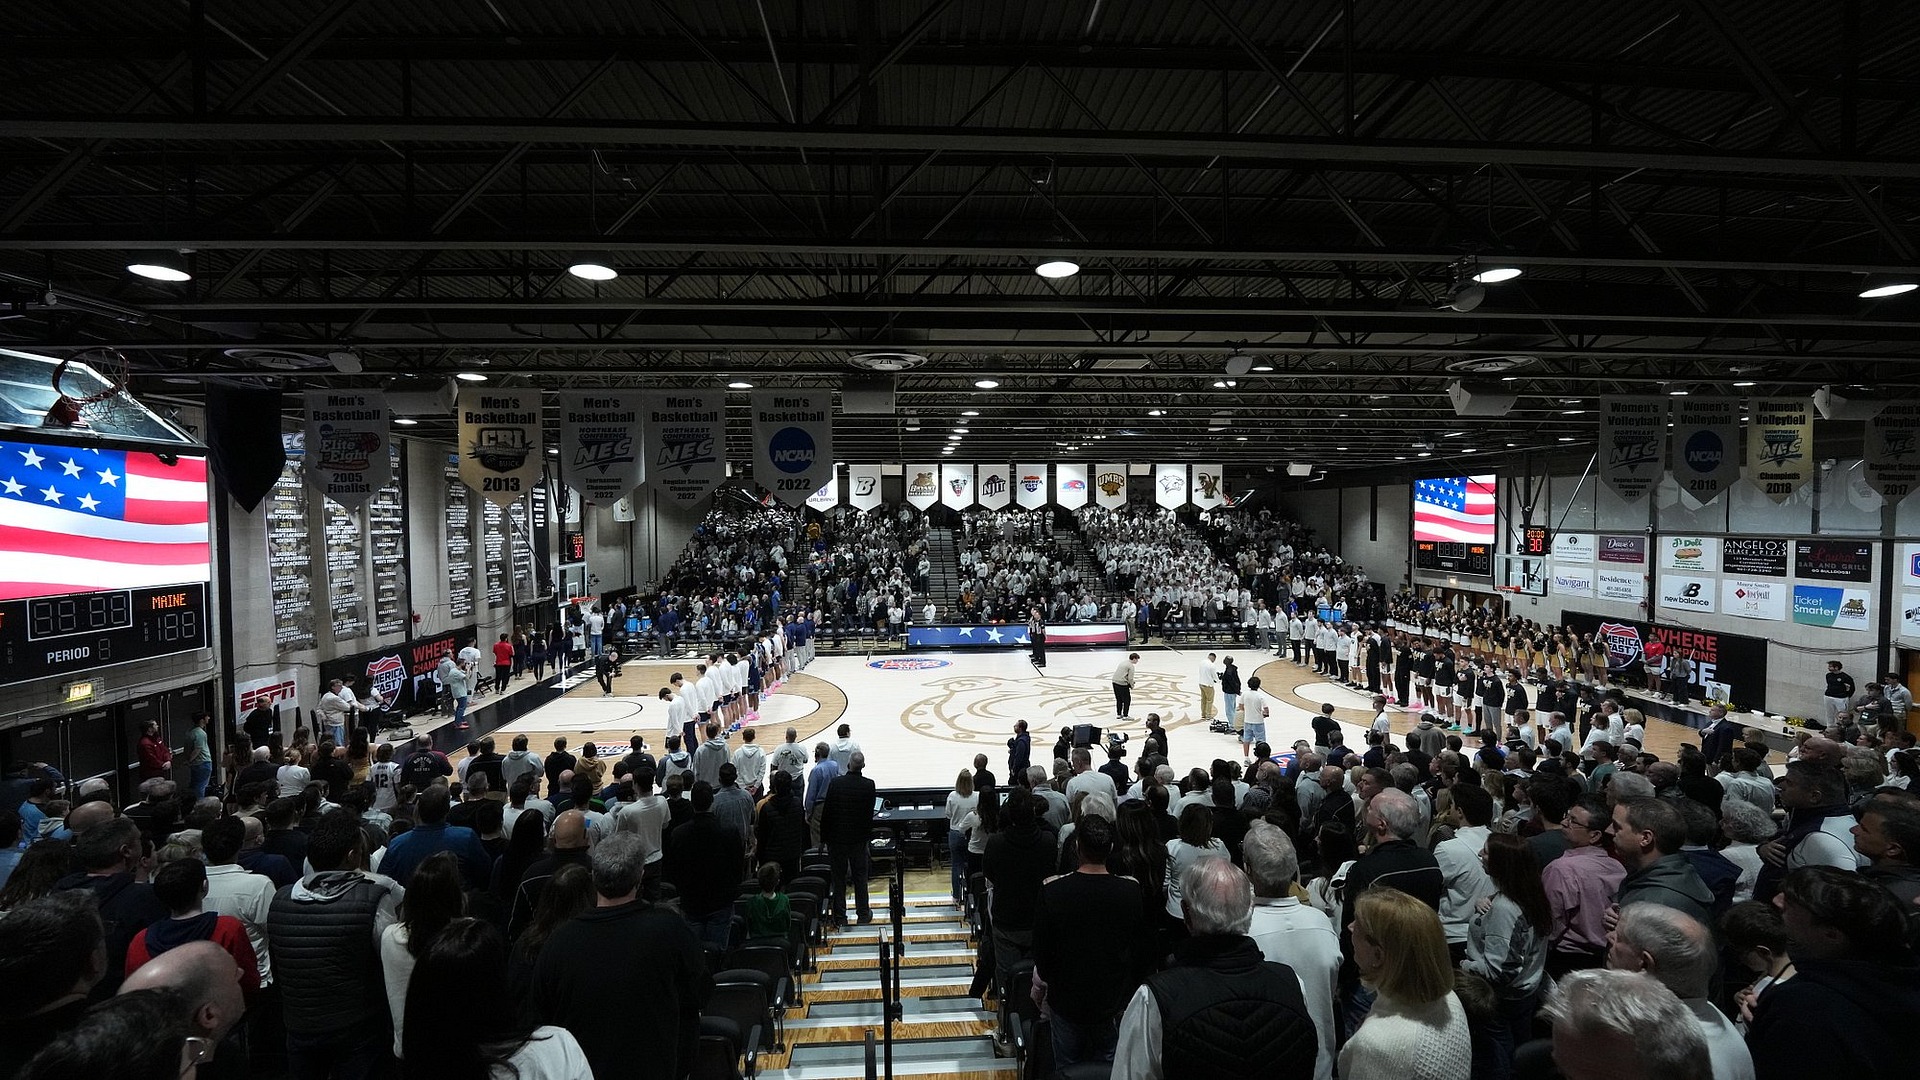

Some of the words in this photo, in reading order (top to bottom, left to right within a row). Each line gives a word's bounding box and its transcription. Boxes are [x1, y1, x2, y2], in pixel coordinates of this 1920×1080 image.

[328, 395, 365, 407] Men's
[481, 396, 520, 409] Men's
[583, 397, 620, 408] Men's
[666, 396, 703, 408] Men's
[774, 397, 810, 408] Men's
[1683, 401, 1730, 412] Women's
[1758, 401, 1805, 412] Women's
[1611, 402, 1660, 413] Women's
[313, 410, 381, 421] Basketball
[465, 411, 537, 424] Basketball
[568, 411, 635, 423] Basketball
[651, 411, 718, 423] Basketball
[760, 411, 825, 422] Basketball
[1607, 416, 1661, 427] Volleyball
[1681, 414, 1732, 426] Volleyball
[1756, 414, 1806, 426] Volleyball
[574, 438, 633, 466] NEC
[657, 438, 715, 466] NEC
[774, 449, 814, 462] NCAA
[333, 472, 363, 483] 2005
[1097, 473, 1125, 486] UMBC
[328, 484, 371, 493] Finalist
[483, 477, 520, 492] 2013
[777, 479, 811, 491] 2022
[1690, 480, 1717, 491] 2018
[1766, 482, 1792, 494] 2018
[1883, 484, 1909, 495] 2017
[1530, 539, 1542, 551] 30
[1607, 538, 1635, 549] Dave's
[1724, 540, 1787, 551] ANGELO'S
[1842, 563, 1867, 571] GRILL
[1555, 576, 1591, 589] Navigant
[1599, 575, 1632, 585] Residence
[152, 593, 187, 610] MAINE
[1678, 596, 1710, 606] balance
[1794, 595, 1823, 606] Ticket
[1793, 604, 1836, 616] Smarter
[47, 646, 90, 664] PERIOD
[373, 667, 405, 685] MERICA
[375, 773, 389, 788] 12
